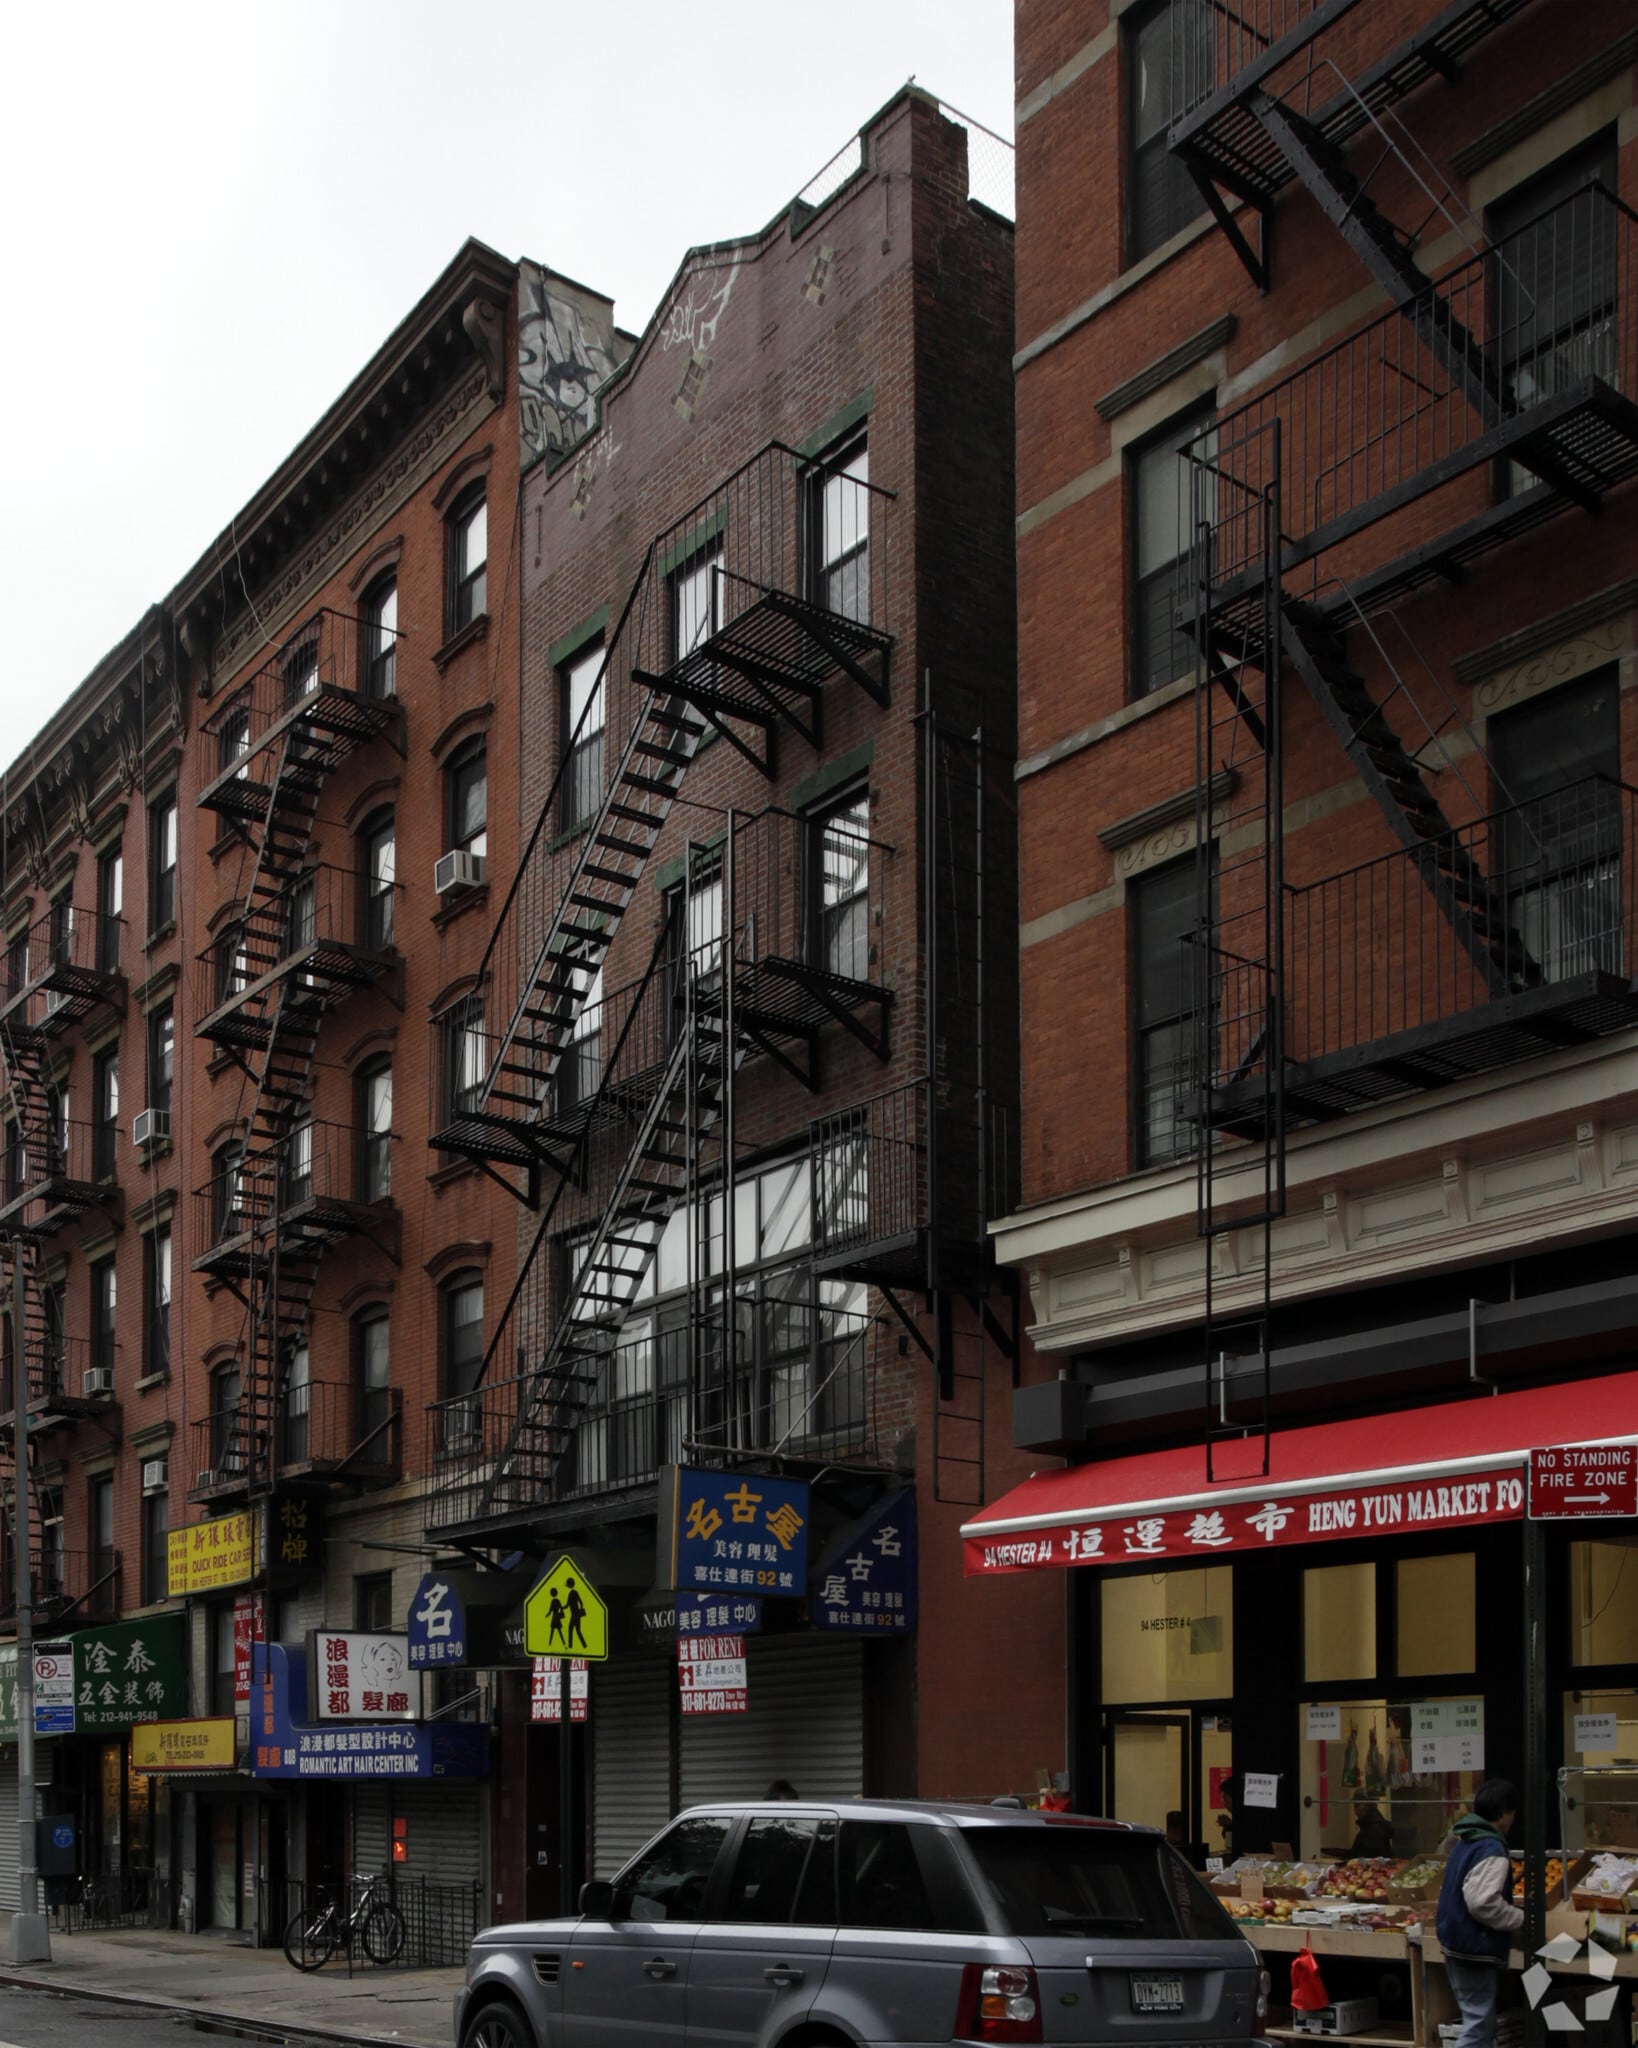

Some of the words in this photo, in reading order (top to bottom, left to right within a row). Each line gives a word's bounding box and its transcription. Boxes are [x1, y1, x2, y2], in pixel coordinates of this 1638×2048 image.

[1537, 1454, 1556, 1468] NO
[1563, 1451, 1631, 1467] STANDING
[1540, 1473, 1575, 1488] FIRE
[1584, 1471, 1627, 1487] ZONE
[1308, 1499, 1357, 1532] HENG
[1362, 1493, 1403, 1527] YUN
[1407, 1482, 1491, 1522] MARKET
[1496, 1478, 1524, 1511] FO
[686, 1482, 804, 1551] 名古屋
[193, 1558, 211, 1574] QUICK
[213, 1554, 228, 1569] RIDE
[983, 1546, 998, 1568] 94
[997, 1541, 1037, 1567] HESTER
[416, 1582, 453, 1639] 名
[644, 1609, 675, 1629] NAGO
[1150, 1616, 1179, 1631] HESTER
[505, 1627, 525, 1647] NAG
[700, 1637, 718, 1660] FOR
[718, 1636, 743, 1659] RENT
[326, 1637, 349, 1714] 浪漫都
[78, 1680, 166, 1707] 五金裝飾
[362, 1691, 410, 1713] 髮廊
[300, 1731, 416, 1753] 浪漫都髮型設計中心
[300, 1756, 337, 1774] ROMANTIC
[338, 1755, 353, 1774] ART
[354, 1755, 374, 1774] HAIR
[374, 1754, 405, 1773] CENTER
[405, 1753, 419, 1773] INC
[1159, 1983, 1180, 2001] 2713
